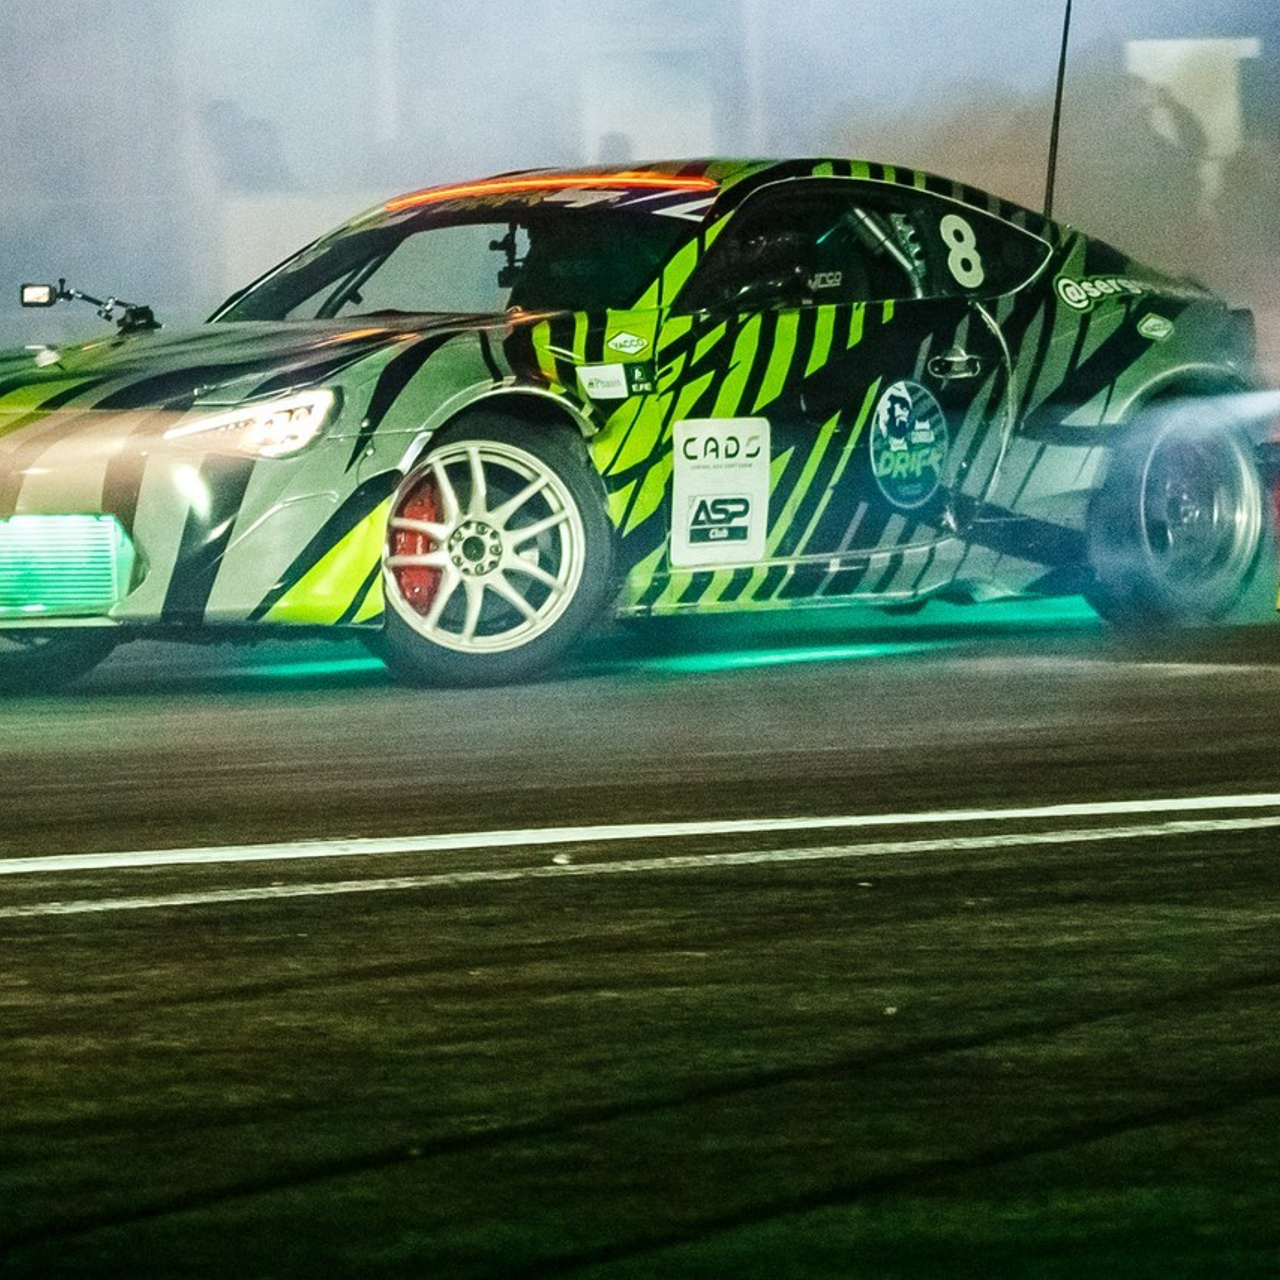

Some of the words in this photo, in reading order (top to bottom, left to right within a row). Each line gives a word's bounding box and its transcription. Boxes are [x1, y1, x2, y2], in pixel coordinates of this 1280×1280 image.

[939, 214, 985, 288] 8
[683, 435, 760, 460] CADS
[691, 498, 750, 526] ASP
